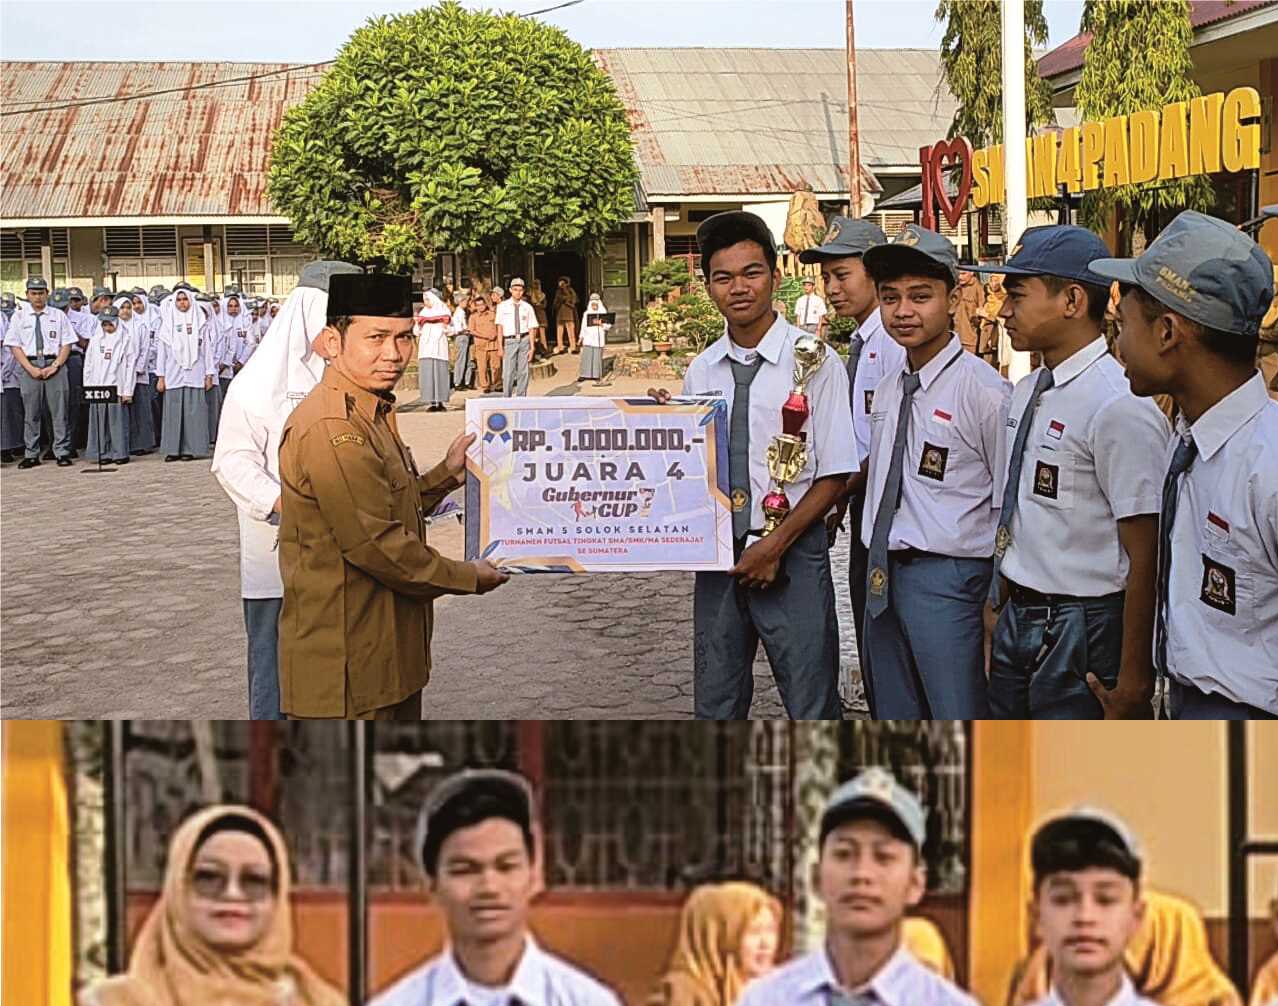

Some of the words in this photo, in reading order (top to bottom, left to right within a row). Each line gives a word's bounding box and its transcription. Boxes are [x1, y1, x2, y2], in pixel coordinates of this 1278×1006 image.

[1056, 126, 1083, 193] 4
[1081, 86, 1262, 191] PADANG
[512, 429, 553, 452] RP.
[562, 428, 704, 453] 1.000.000,-
[522, 462, 646, 482] JUARA
[666, 461, 685, 481] 4
[542, 487, 637, 503] Gubernur
[598, 503, 638, 518] CUP
[516, 527, 554, 535] SMAN
[562, 526, 568, 535] 5
[576, 525, 621, 534] SOLOK
[629, 525, 689, 534] SELATAN
[573, 537, 606, 545] TINGKAT
[661, 536, 704, 544] SEDERAJAT
